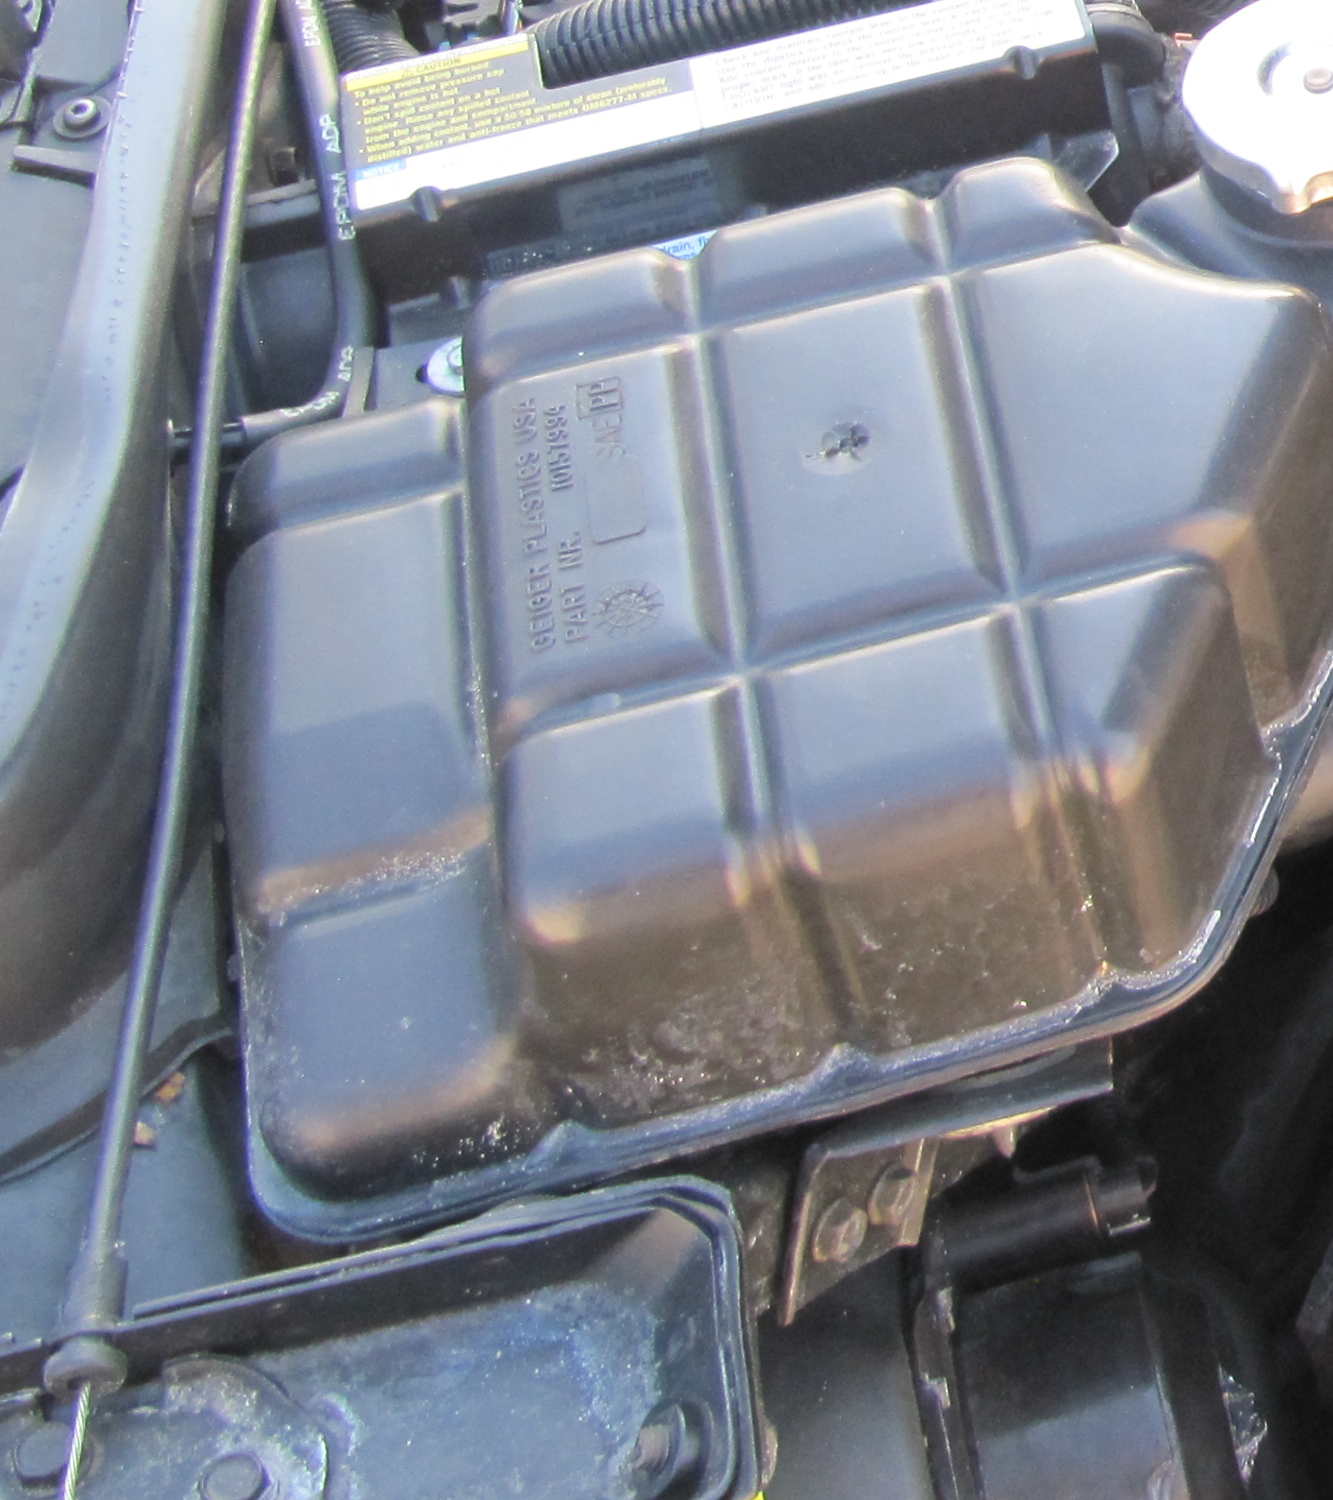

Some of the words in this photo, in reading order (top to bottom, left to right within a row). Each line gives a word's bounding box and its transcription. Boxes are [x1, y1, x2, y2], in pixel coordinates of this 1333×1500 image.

[354, 90, 365, 98] To
[367, 84, 391, 96] help
[393, 77, 422, 89] avoid
[423, 70, 452, 83] being
[454, 61, 489, 75] burned
[415, 57, 461, 73] CAUTION
[361, 96, 377, 106] Do
[378, 91, 396, 102] not
[399, 83, 437, 97] remove
[439, 73, 484, 89] pressure
[319, 112, 343, 154] ADP
[362, 162, 400, 178] NOTICE
[330, 170, 356, 241] EPDM
[512, 397, 539, 446] USA
[543, 404, 575, 494] 10157994
[515, 451, 549, 558] PLASTICS
[558, 530, 584, 572] NR.
[526, 563, 557, 654] GEIGER
[559, 584, 591, 644] PART
